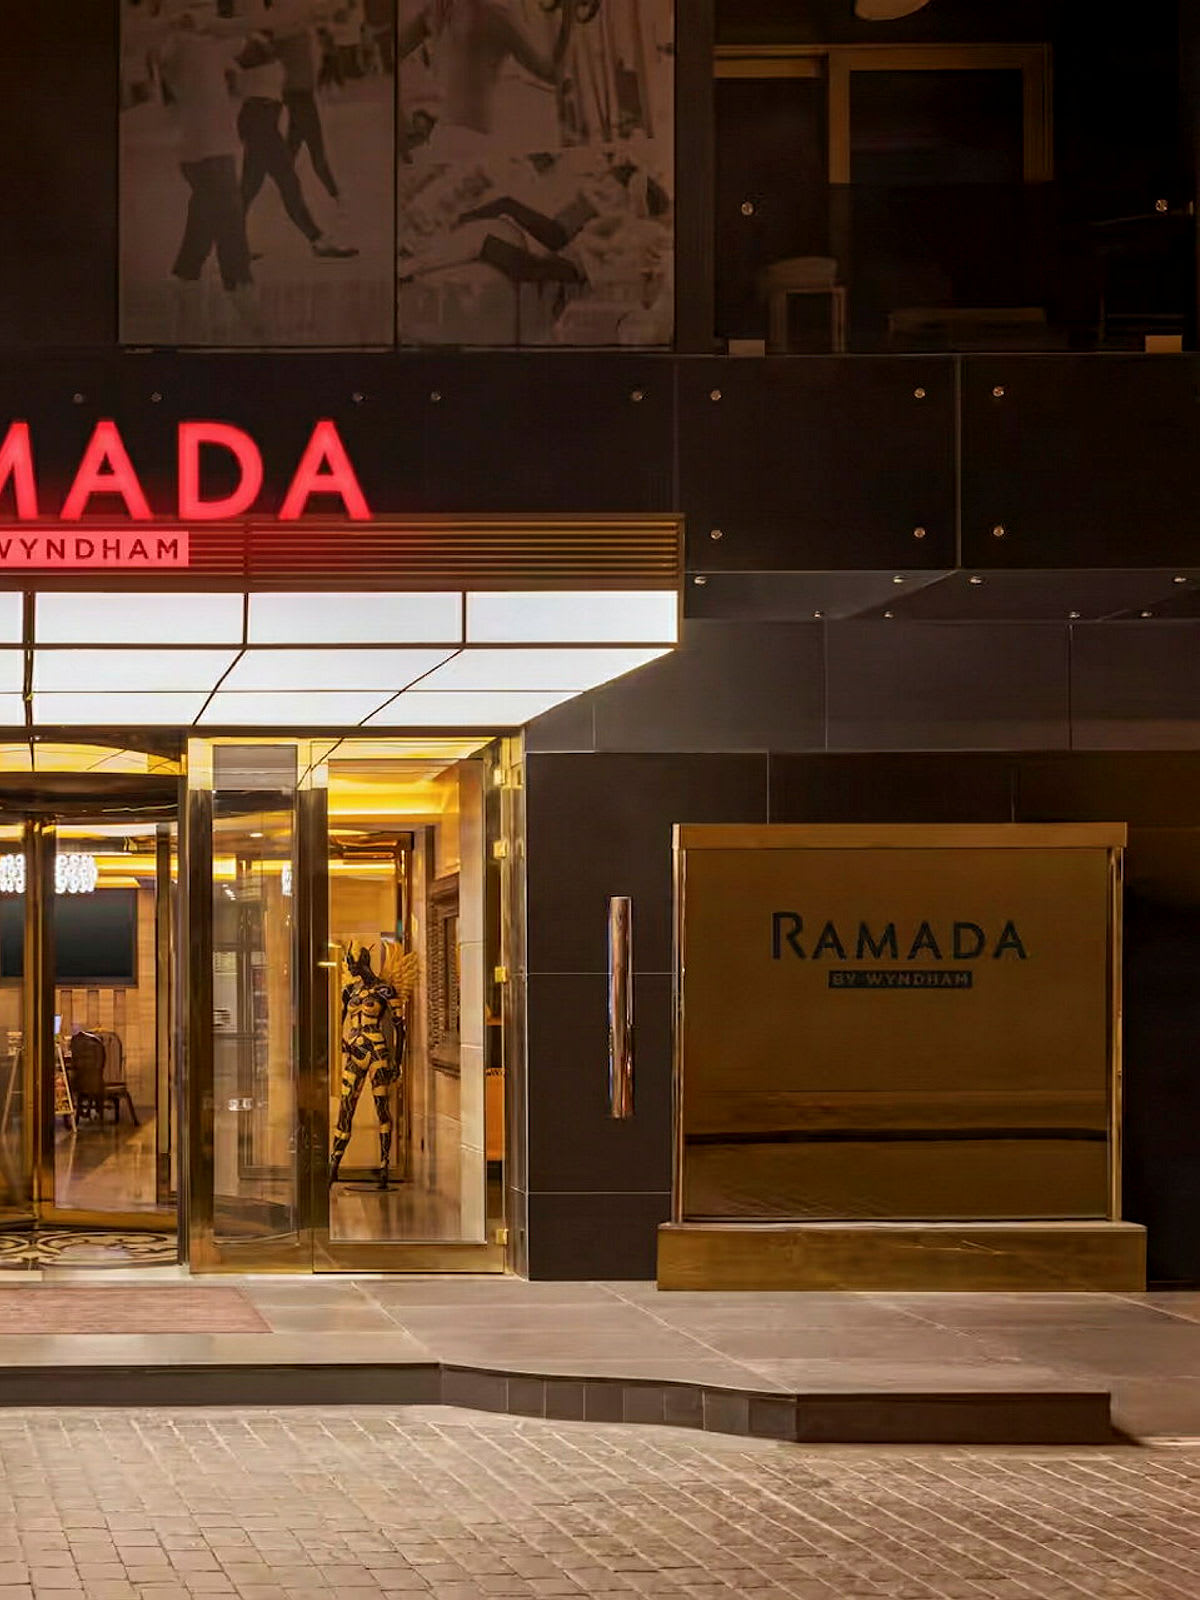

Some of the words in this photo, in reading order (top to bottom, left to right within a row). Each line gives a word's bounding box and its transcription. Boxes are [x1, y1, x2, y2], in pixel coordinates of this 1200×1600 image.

[771, 911, 1028, 961] RAMADA
[833, 973, 856, 985] BY
[865, 973, 969, 985] WYNDHAM
